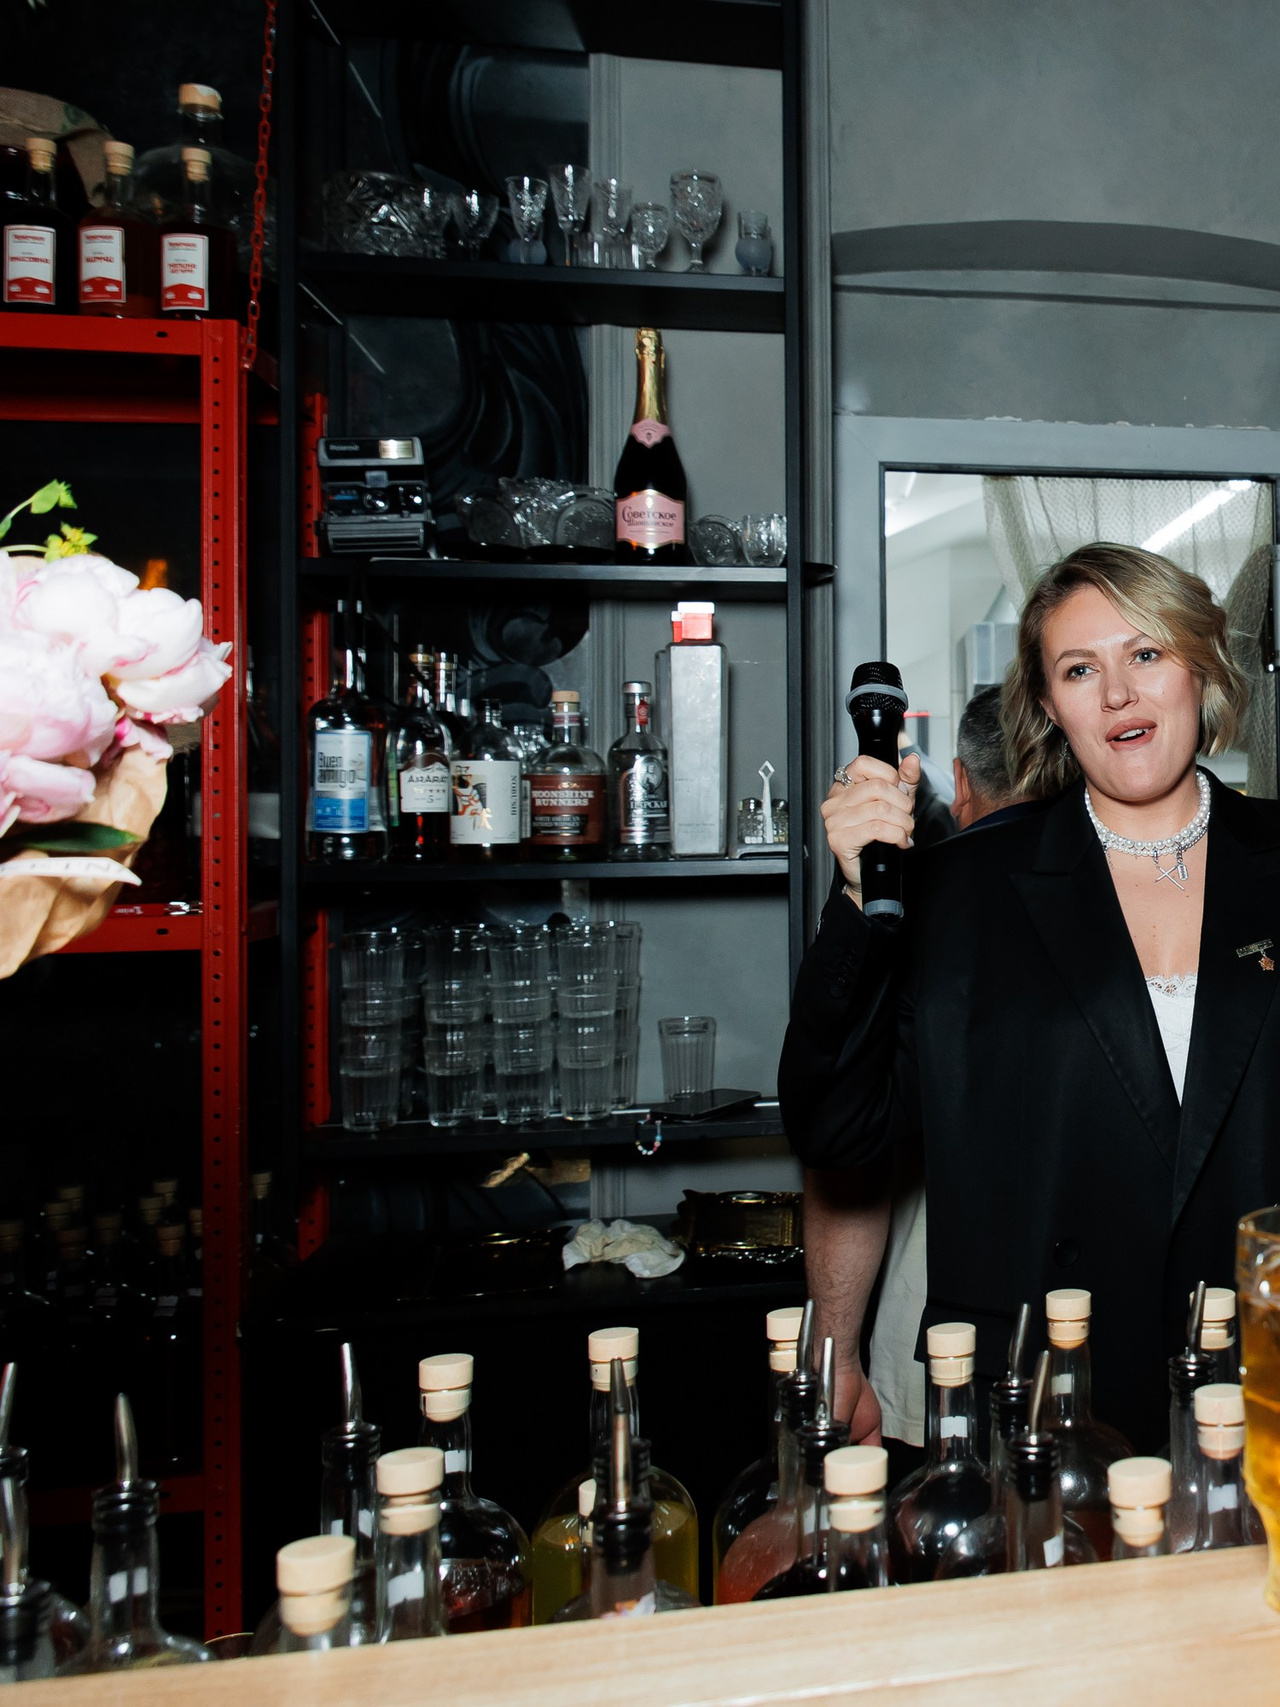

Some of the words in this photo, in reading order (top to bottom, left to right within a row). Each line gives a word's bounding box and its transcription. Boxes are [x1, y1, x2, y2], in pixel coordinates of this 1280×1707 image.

[622, 506, 677, 523] Советское
[532, 790, 594, 798] MOONSHINE
[535, 798, 589, 806] RUNNERS
